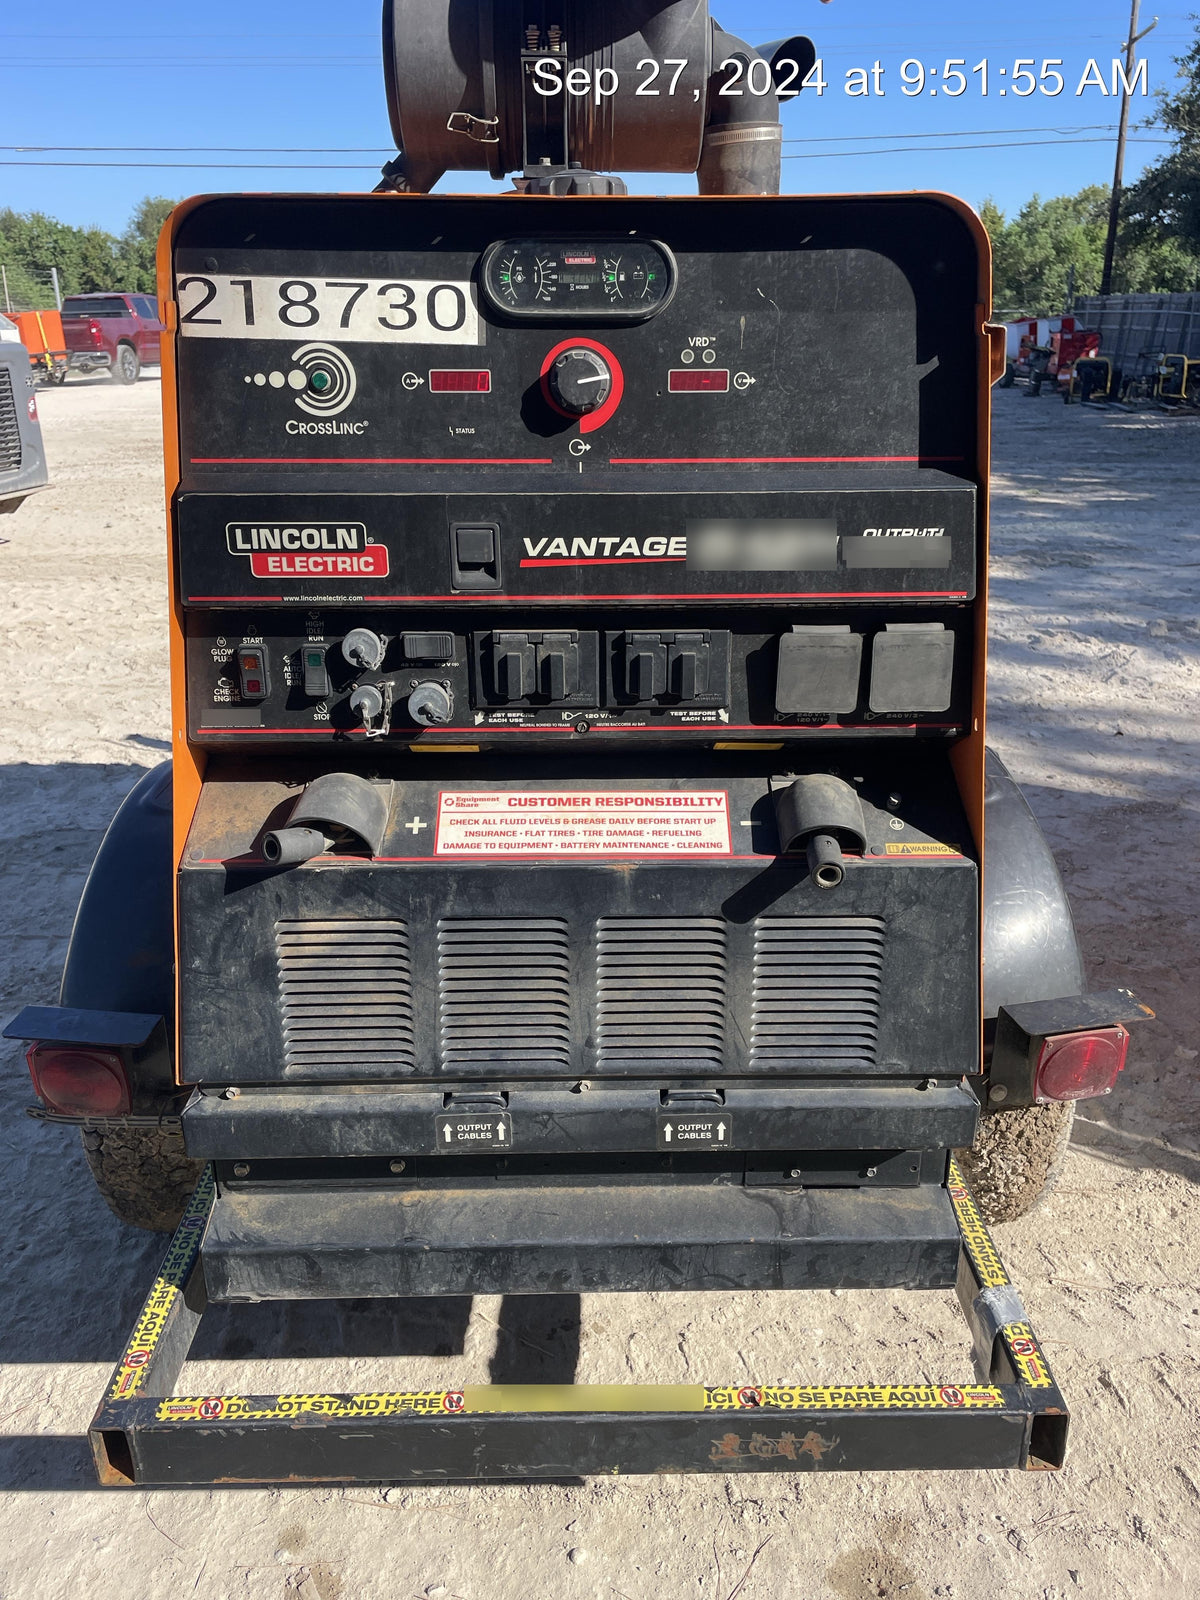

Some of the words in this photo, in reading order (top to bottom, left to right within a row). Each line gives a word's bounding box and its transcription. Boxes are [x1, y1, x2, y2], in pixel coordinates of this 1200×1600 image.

[177, 276, 466, 332] 218730
[235, 528, 358, 550] LINCOLN
[522, 537, 687, 558] VANTAGE
[267, 556, 374, 573] ELECTRIC
[210, 648, 234, 656] GLOW
[213, 688, 240, 696] CHECK
[507, 796, 591, 807] CUSTOMER
[595, 796, 722, 807] RESPONSIBILITY
[449, 817, 479, 825] CHECK
[481, 817, 498, 825] ALL
[500, 817, 527, 825] FLUID
[529, 817, 561, 825] LEVELS
[563, 817, 569, 825] &
[571, 817, 606, 825] GREASE
[608, 817, 635, 825] DAILY
[637, 817, 671, 825] BEFORE
[673, 817, 701, 825] START
[703, 817, 716, 825] UP
[443, 841, 482, 849] DAMAGE
[485, 841, 496, 849] TO
[498, 841, 554, 849] EQUIPMENT
[560, 841, 600, 849] BATTERY
[603, 841, 670, 849] MAINTENANCE
[676, 841, 723, 849] CLEANING
[457, 1123, 492, 1132] OUTPUT
[677, 1123, 713, 1131] OUTPUT
[457, 1131, 492, 1140] CABLES
[677, 1131, 712, 1139] CABLES
[957, 1201, 980, 1233] HERE
[178, 1231, 194, 1250] NO
[169, 1252, 185, 1270] SE
[973, 1235, 1000, 1279] STAND
[152, 1272, 177, 1308] PARE
[706, 1392, 733, 1403] ICI
[764, 1391, 794, 1403] NO
[798, 1392, 826, 1403] SE
[829, 1391, 887, 1403] PARE
[310, 1399, 379, 1411] STAND
[384, 1398, 441, 1410] HERE
